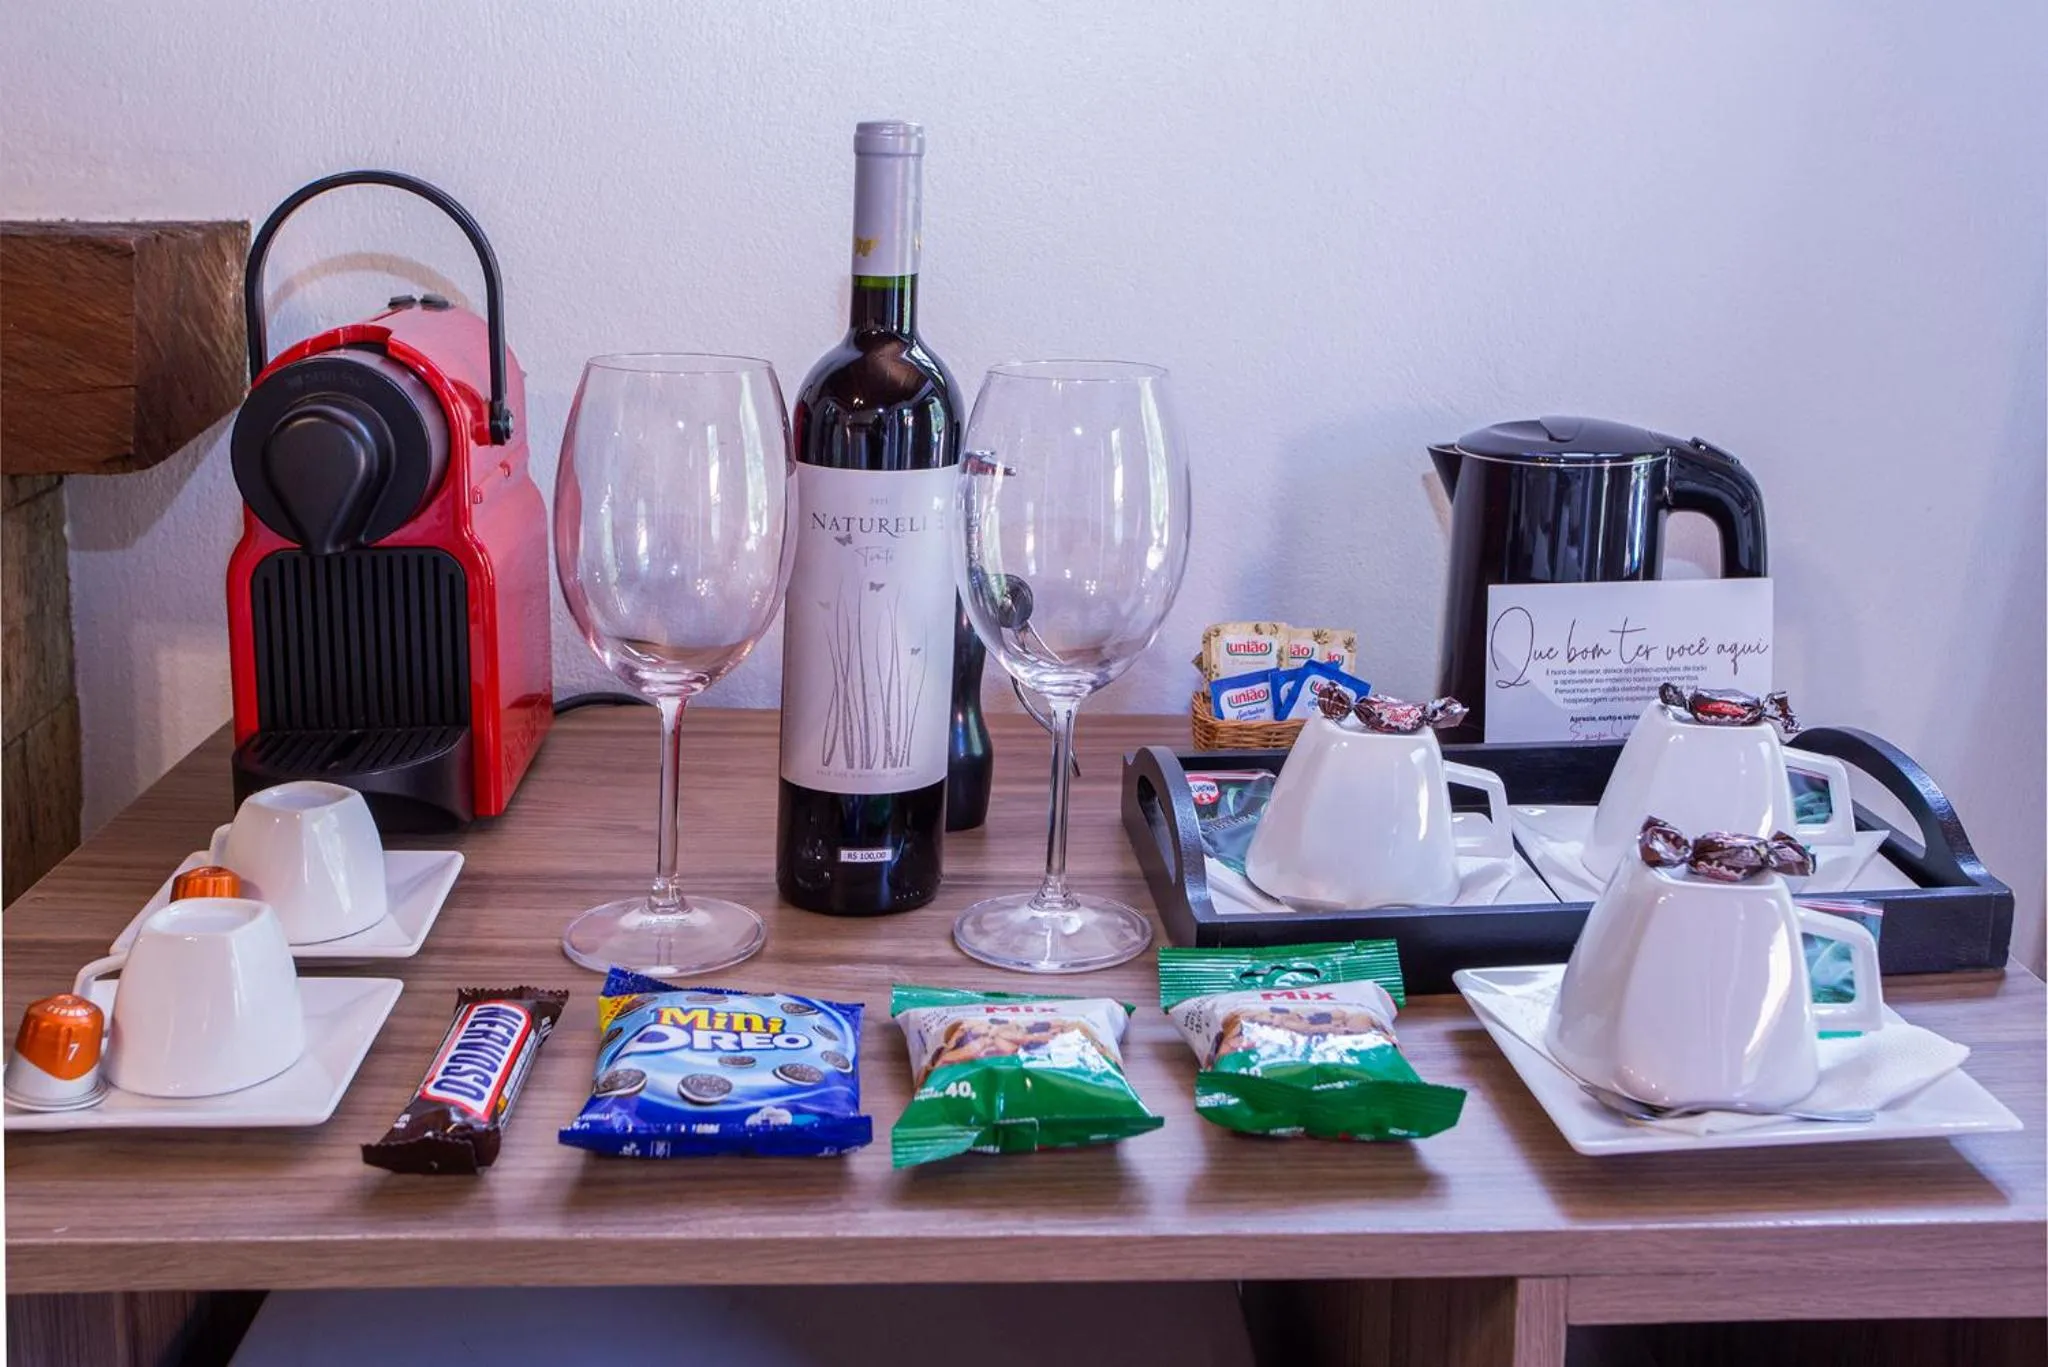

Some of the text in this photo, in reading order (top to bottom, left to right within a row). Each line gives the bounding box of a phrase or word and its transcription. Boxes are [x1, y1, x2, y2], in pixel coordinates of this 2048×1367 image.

[1228, 641, 1268, 652] união
[1490, 606, 1769, 689] Que bom ter você aqui
[1260, 990, 1336, 1001] Mix
[656, 1007, 786, 1035] Mini
[68, 1042, 81, 1062] 7
[614, 1025, 811, 1054] OREO
[432, 1006, 525, 1103] NERVOSO
